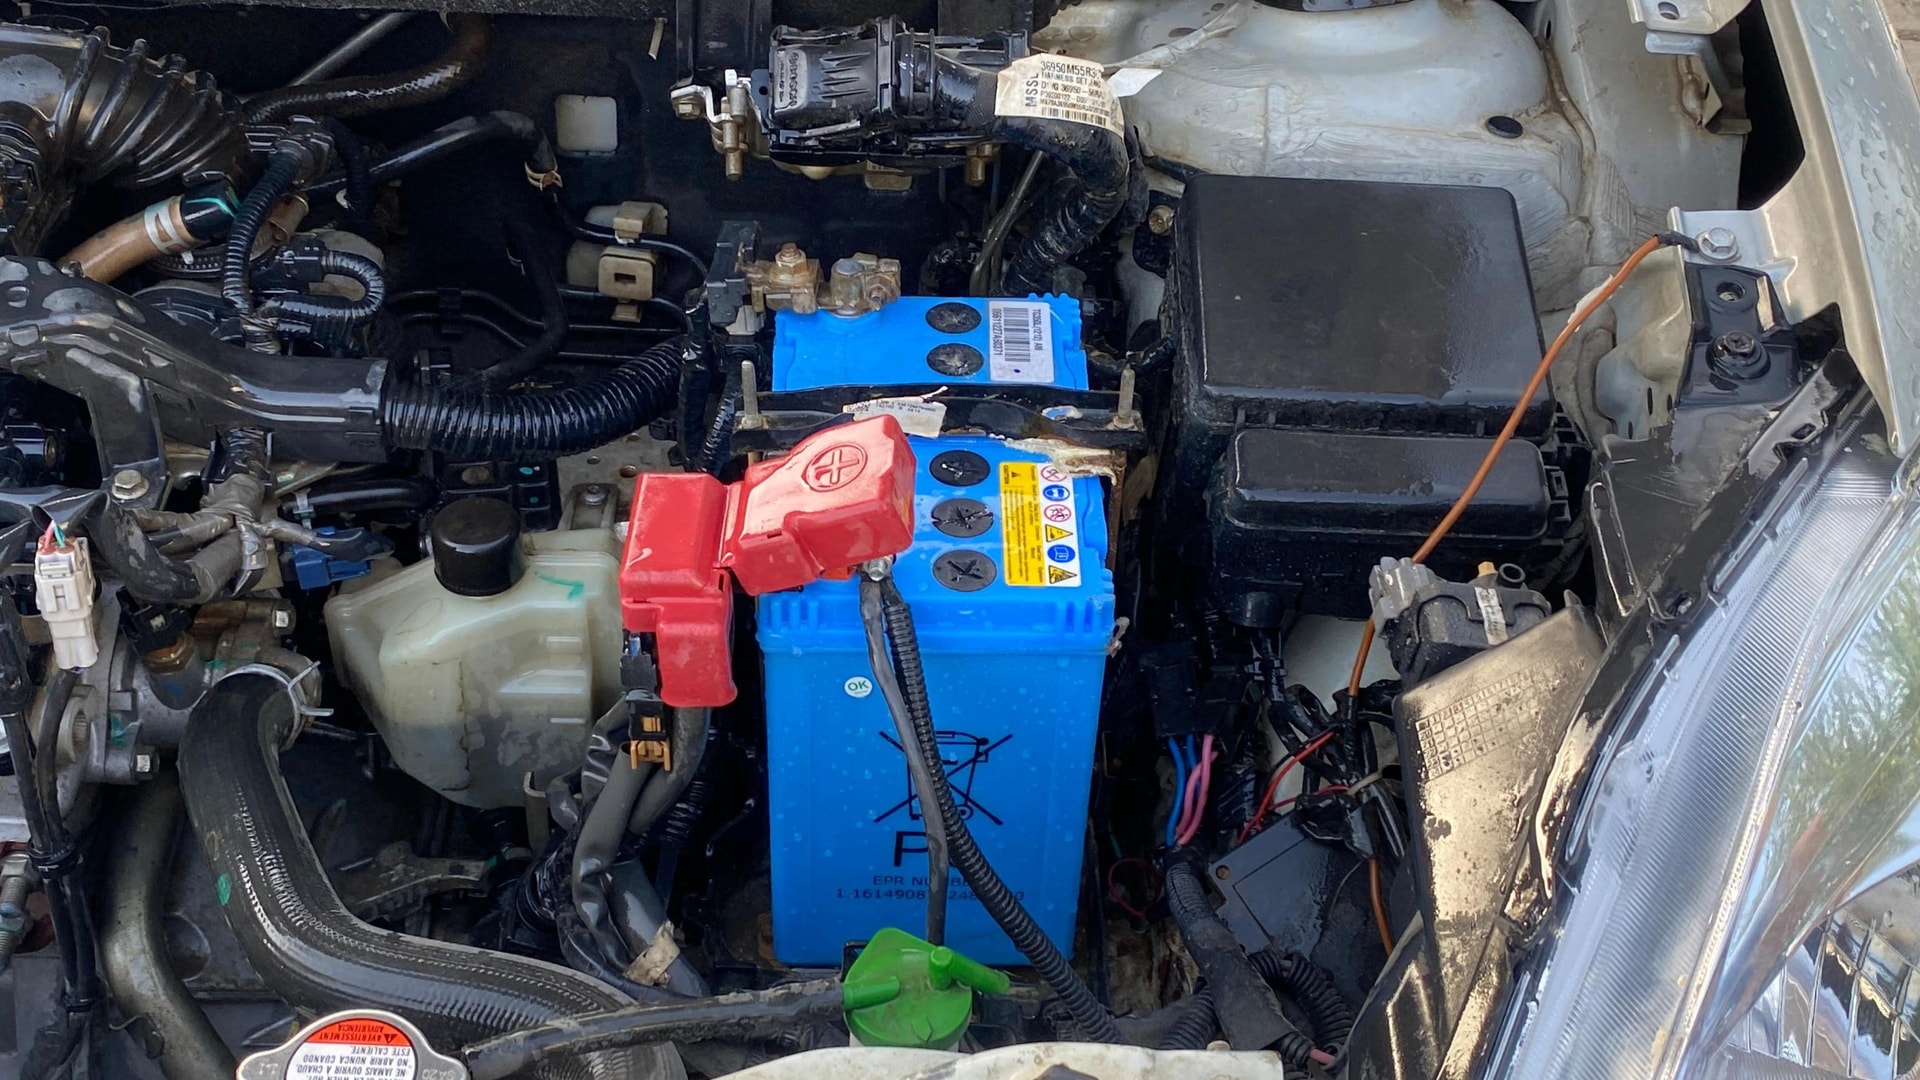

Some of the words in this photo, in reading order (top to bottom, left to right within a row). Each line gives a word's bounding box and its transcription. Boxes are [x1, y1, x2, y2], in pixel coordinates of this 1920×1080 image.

[1025, 73, 1039, 107] MSSL
[848, 680, 870, 691] OK
[873, 875, 904, 886] EPR
[338, 1023, 384, 1032] ADVERTENCIA
[319, 1032, 381, 1042] AVERTISSEMENT
[391, 1047, 411, 1056] ESTE
[303, 1054, 336, 1063] CUANDO
[340, 1056, 366, 1065] NUNCA
[370, 1057, 394, 1066] ABRIR
[397, 1058, 409, 1066] NO
[334, 1066, 362, 1075] OUVRIR
[365, 1067, 392, 1076] JAMAIS
[395, 1068, 406, 1077] NE
